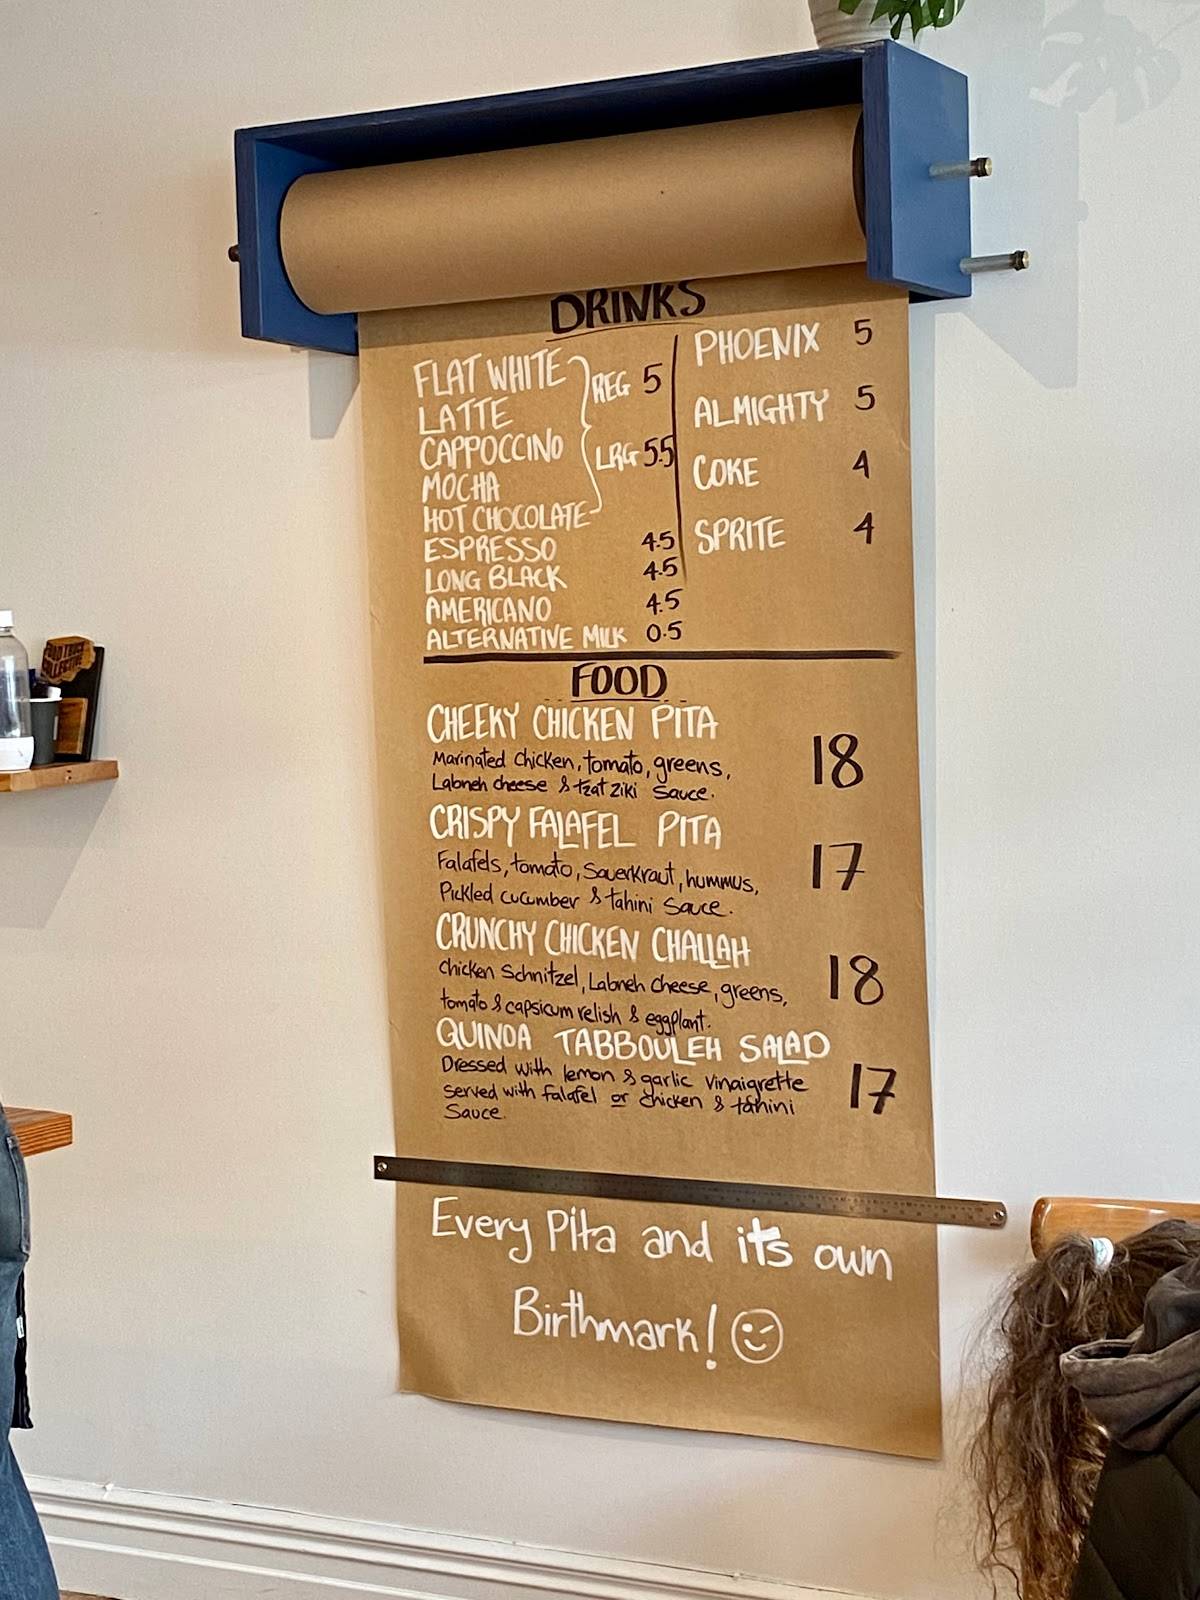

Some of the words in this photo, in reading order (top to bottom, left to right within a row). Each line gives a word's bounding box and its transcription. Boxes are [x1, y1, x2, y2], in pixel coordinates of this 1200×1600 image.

[550, 280, 706, 335] DRINKS
[694, 321, 821, 367] PHOENIX
[853, 318, 873, 346] 5
[413, 353, 482, 398] FLAT
[486, 347, 567, 394] WHITE
[591, 370, 632, 404] REG
[643, 362, 663, 394] 5
[418, 396, 514, 435] LATTE
[694, 388, 830, 429] ALMIGHTY
[854, 384, 876, 411] 5
[419, 427, 565, 471] CAPPOCCINO
[595, 442, 640, 472] LRG
[643, 434, 676, 467] 5.5
[852, 450, 870, 479] 4
[422, 471, 501, 504] MOCHA
[692, 454, 760, 491] COKE
[423, 504, 468, 533] HOT
[472, 500, 591, 531] CHOCOLATE
[694, 515, 787, 555] SPRITE
[853, 512, 875, 545] 4
[424, 534, 558, 564] ESPRESSO
[641, 531, 676, 552] 4.5
[425, 567, 481, 595] LONG
[488, 564, 568, 592] BLACK
[643, 556, 679, 581] 4.5
[425, 595, 552, 627] AMERICANO
[646, 588, 684, 616] 4.5
[426, 624, 574, 650] ALTERNATIVE
[582, 624, 628, 649] MILK
[646, 621, 683, 643] 0.5
[571, 662, 668, 699] FOOD
[427, 702, 520, 743] CHEEKY
[532, 705, 635, 741] CHICKEN
[650, 704, 719, 740] PITA
[432, 747, 506, 768] Marinated
[584, 750, 651, 779] tomato,
[653, 756, 732, 784] greens,
[813, 733, 864, 788] 18
[432, 773, 488, 792] Labneh
[429, 804, 521, 848] CRISPY
[529, 806, 637, 850] FALAFEL
[657, 811, 722, 850] PITA
[437, 849, 508, 878] Falafels,
[510, 852, 580, 882] tomato,
[685, 869, 760, 896] hummus,
[812, 842, 865, 891] 17
[440, 880, 494, 905] Pickled
[500, 888, 580, 910] cucumber
[605, 887, 653, 914] tahini
[435, 911, 537, 957] CRUNCHY
[544, 919, 640, 963] CHICKEN
[651, 926, 752, 970] CHALLAH
[589, 972, 646, 995] Labneh
[720, 983, 788, 1009] greens,
[829, 954, 884, 1006] 18
[440, 988, 488, 1012] tomato
[505, 999, 574, 1019] capsicum
[577, 1002, 622, 1025] relish
[645, 1008, 712, 1037] eggplant.
[553, 1027, 723, 1067] TABBOULEH
[739, 1029, 831, 1067] SALAD
[441, 1055, 507, 1074] Dressed
[515, 1057, 552, 1077] with
[564, 1063, 615, 1083] lemon
[641, 1071, 693, 1095] garlic
[849, 1062, 897, 1115] 17
[503, 1079, 536, 1099] with
[542, 1084, 598, 1104] falafel
[611, 1091, 630, 1108] or
[730, 1096, 795, 1116] tahini
[432, 1196, 533, 1264] Every
[546, 1205, 617, 1254] Pita
[641, 1220, 713, 1260] and
[737, 1216, 793, 1267] its
[814, 1244, 893, 1281] own
[513, 1286, 718, 1371] Birthmark!
